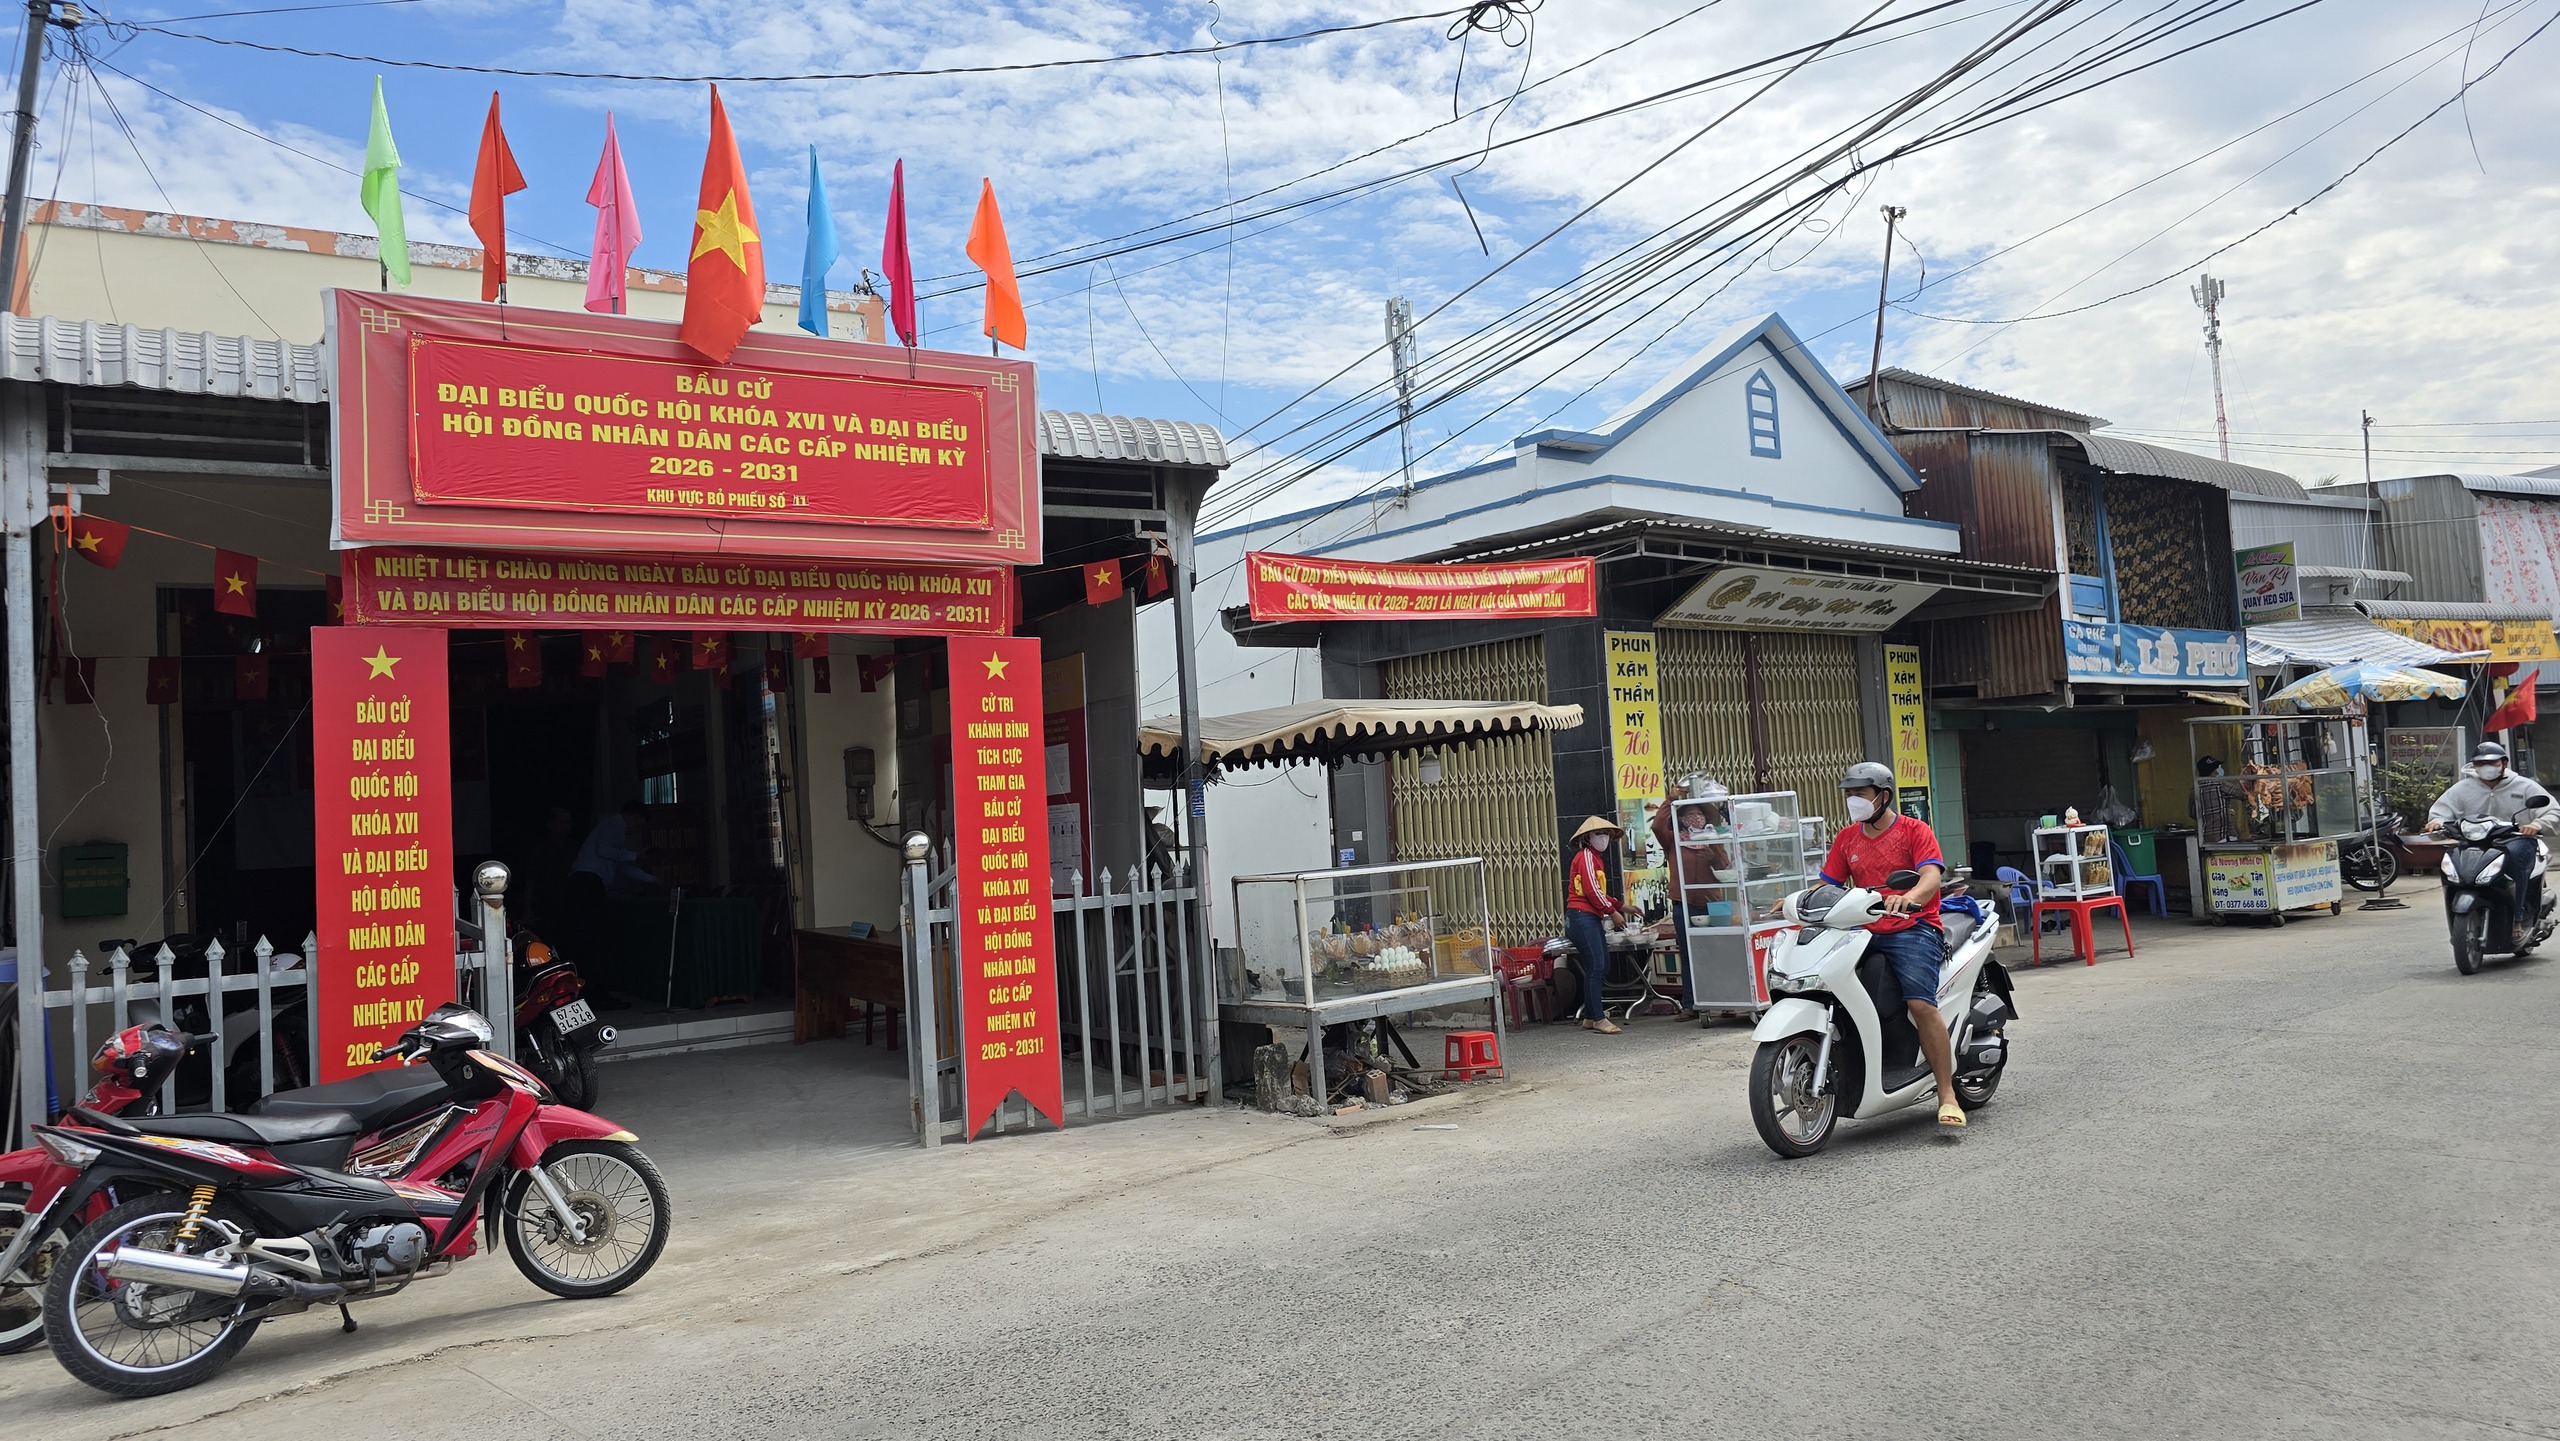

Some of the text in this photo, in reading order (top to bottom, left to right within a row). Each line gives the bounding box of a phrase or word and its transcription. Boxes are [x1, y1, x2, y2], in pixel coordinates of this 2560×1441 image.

[676, 371, 773, 400] BẦU CỬ
[438, 383, 968, 442] ĐẠI BIỂU QUỐC HỘI KHÓA XVI VÀ ĐẠI BIỂU
[442, 412, 967, 467] HỘI ĐỒNG NHÂN DÂN CÁC CẤP NHIỆM KỲ
[650, 456, 798, 482] 2026 2031
[647, 488, 674, 503] KHU
[677, 489, 704, 507] VỰC
[707, 488, 725, 506] BỎ
[728, 490, 766, 508] PHIẾU
[768, 491, 786, 508] SỐ
[375, 553, 992, 596] NHIỆT LIỆT CHÀO MỪNG NGÀY BẦU CỬ ĐẠI BIỂU QUỐC HỘI KHÓA XVI
[1260, 561, 1282, 582] BẦU
[1284, 563, 1300, 582] CỬ
[1301, 569, 1320, 586] ĐẠI
[1323, 564, 1347, 584] BIỂU
[1348, 566, 1376, 587] QUỐC
[1376, 569, 1394, 588] HỘI
[1395, 570, 1423, 586] KHÓA
[1423, 572, 1441, 585] XVI
[1441, 570, 1455, 585] VÀ
[1455, 572, 1474, 588] ĐẠI
[1475, 567, 1497, 585] BIỂU
[1500, 570, 1513, 588] HỘI
[1516, 567, 1540, 584] ĐỒNG
[377, 585, 990, 624] VÀ ĐẠI BIỂU HỘI ĐỒNG NHÂN DÂN CÁC CẤP NHIỆM KỲ 2026 2031!
[1287, 590, 1308, 610] CÁC
[1312, 589, 1331, 609] CẤP
[1332, 592, 1366, 613] NHIỆM
[1368, 592, 1382, 610] KỲ
[1383, 596, 1408, 610] 2026
[1414, 596, 1438, 610] 2031
[1439, 592, 1452, 610] LÀ
[1453, 592, 1481, 610] NGÀY
[1480, 592, 1496, 612] HỘI
[1497, 590, 1517, 609] CỦA
[1517, 591, 1542, 608] TOÀN
[2243, 596, 2261, 610] QUAY
[1611, 638, 1651, 652] PHUN
[2085, 626, 2106, 641] PHÊ
[1889, 651, 1917, 664] PHUN
[2137, 630, 2180, 675] LÊ
[1616, 661, 1648, 677] XĂM
[1894, 671, 1916, 685] XĂM
[981, 692, 1014, 713] CỬ TRI
[1613, 682, 1654, 702] THẨM
[1892, 689, 1921, 706] THẨM
[356, 694, 412, 724] BẦU CỬ
[1625, 710, 1645, 727] MỸ
[1901, 712, 1915, 727] MỸ
[968, 720, 1003, 739] KHÁNH
[1005, 719, 1029, 738] BÌNH
[352, 729, 415, 766] ĐẠI BIỂU
[1623, 729, 1650, 756] Hồ
[977, 746, 1023, 767] TÍCH CỰC
[350, 768, 418, 802] QUỐC HỘI
[977, 774, 1026, 791] THAM GIA
[1617, 763, 1660, 795] Điệp
[983, 795, 1022, 817] BẦU CỬ
[351, 809, 419, 836] KHÓA XVI
[982, 820, 1025, 847] ĐẠI BIỂU
[342, 840, 428, 878] VÀ ĐẠI BIỂU
[981, 848, 1029, 872] QUỐC HỘI
[983, 877, 1029, 897] KHÓA XVI
[2212, 873, 2226, 881] Giao
[351, 880, 421, 917] HỘI ĐỒNG
[977, 899, 1037, 926] VÀ ĐẠI BIỂU
[349, 919, 425, 951] NHÂN DÂN
[984, 927, 1033, 953] HỘI ĐỒNG
[356, 954, 420, 989] CÁC CẤP
[983, 955, 1036, 978] NHÂN DÂN
[988, 980, 1033, 1005] CÁC CẤP
[353, 994, 425, 1030] NHIỆM KỲ
[556, 1003, 583, 1020] 67-G1
[559, 1011, 593, 1031] 343.48
[987, 1008, 1037, 1033] NHIỆM KỲ
[981, 1037, 1044, 1060] 2026 2031!
